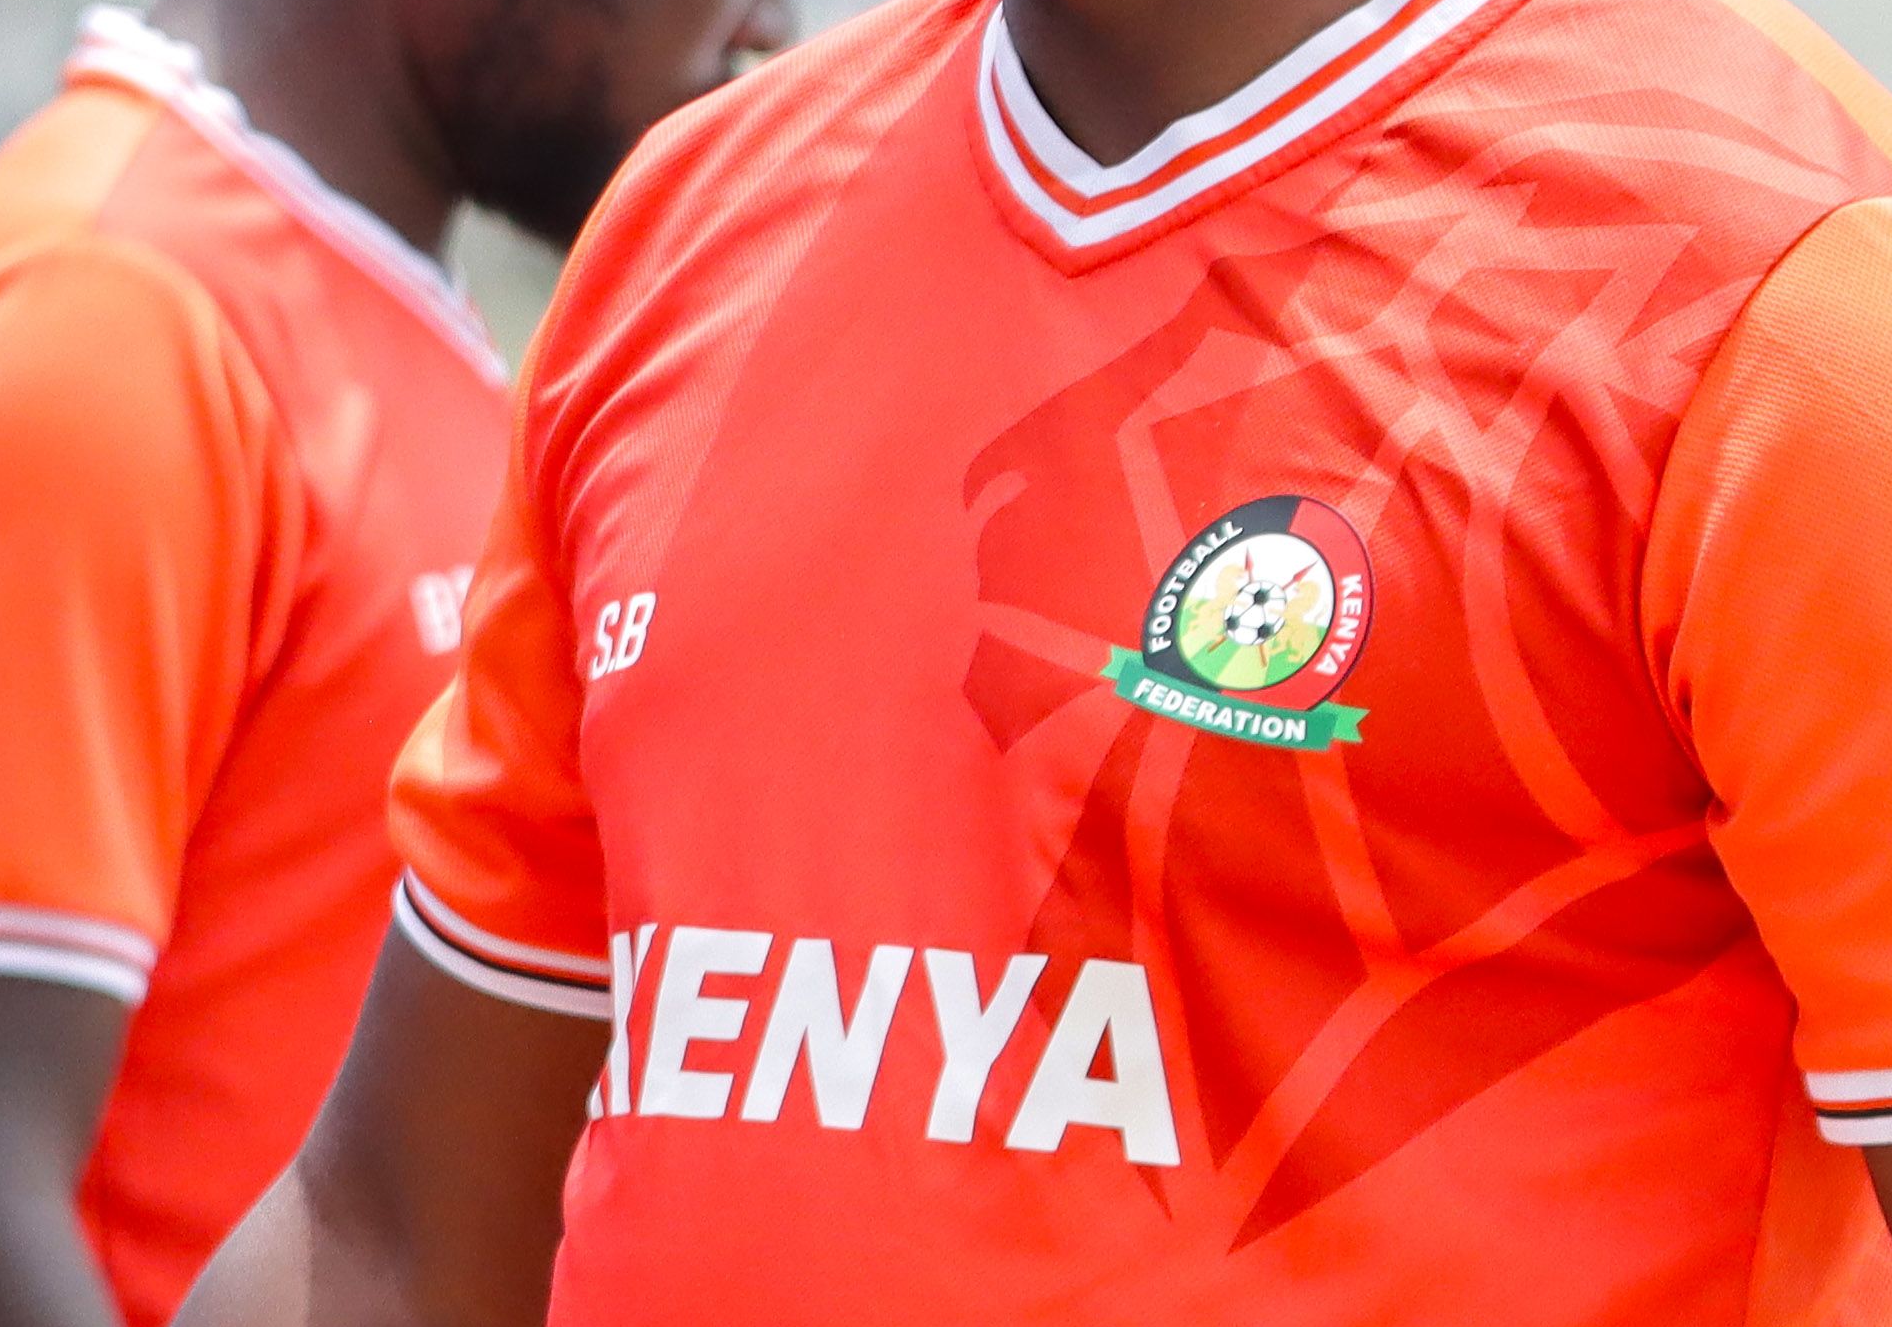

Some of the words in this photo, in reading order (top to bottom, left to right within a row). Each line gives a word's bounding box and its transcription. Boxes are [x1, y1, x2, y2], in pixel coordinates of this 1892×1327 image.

[1148, 520, 1243, 654] FOOTBALL
[1314, 573, 1364, 676] KENYA
[588, 591, 656, 681] S.B
[1133, 678, 1307, 742] FEDERATION
